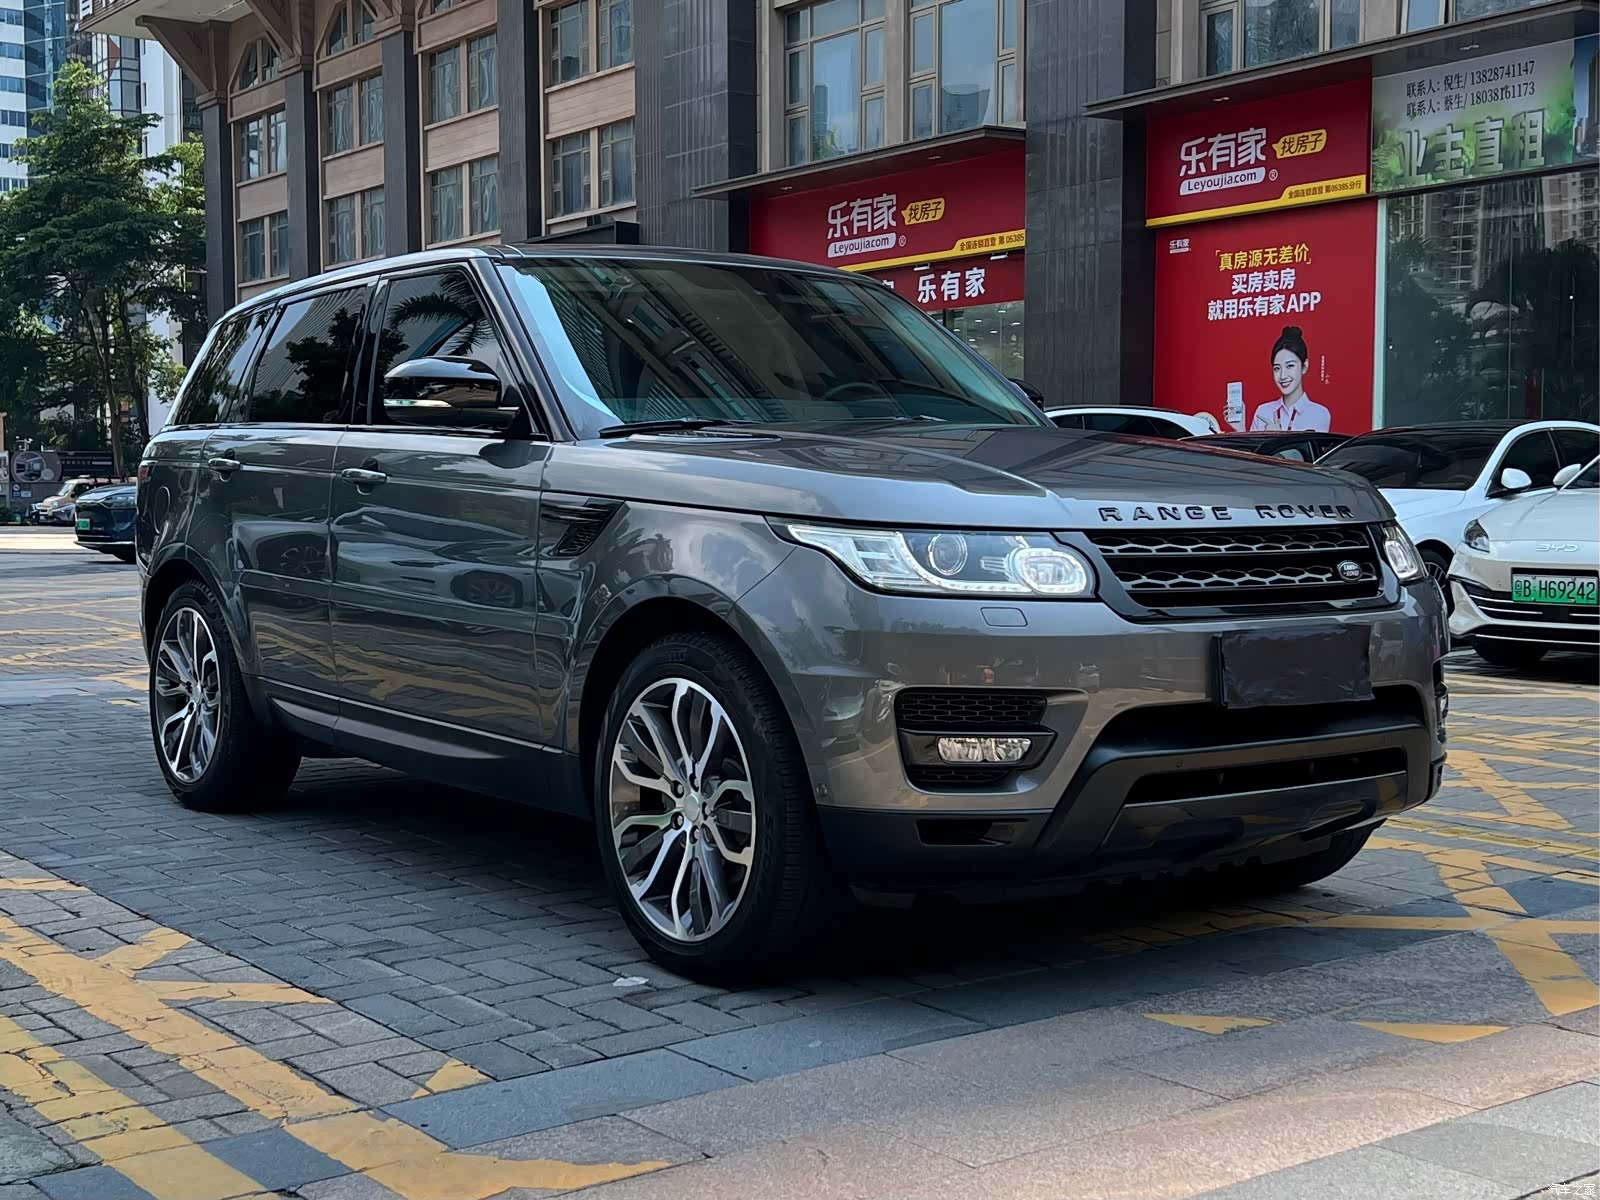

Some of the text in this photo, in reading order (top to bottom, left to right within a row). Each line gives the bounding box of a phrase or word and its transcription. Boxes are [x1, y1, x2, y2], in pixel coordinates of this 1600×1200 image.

[1470, 60, 1535, 85] 13828741147
[1179, 127, 1267, 177] 乐有家
[1281, 132, 1323, 156] 找房子
[1398, 108, 1545, 182] 业主直租
[1187, 170, 1257, 192] Leyoujia.com
[827, 193, 897, 240] 乐有家
[908, 201, 943, 223] 找房子
[833, 236, 889, 256] Leyoujia.com
[917, 266, 986, 304] 乐有家
[1231, 268, 1296, 295] 买房卖房
[1207, 291, 1322, 321] 就用乐有家APP
[1098, 504, 1355, 521] RANGE ROVER
[1536, 543, 1579, 552] BYD
